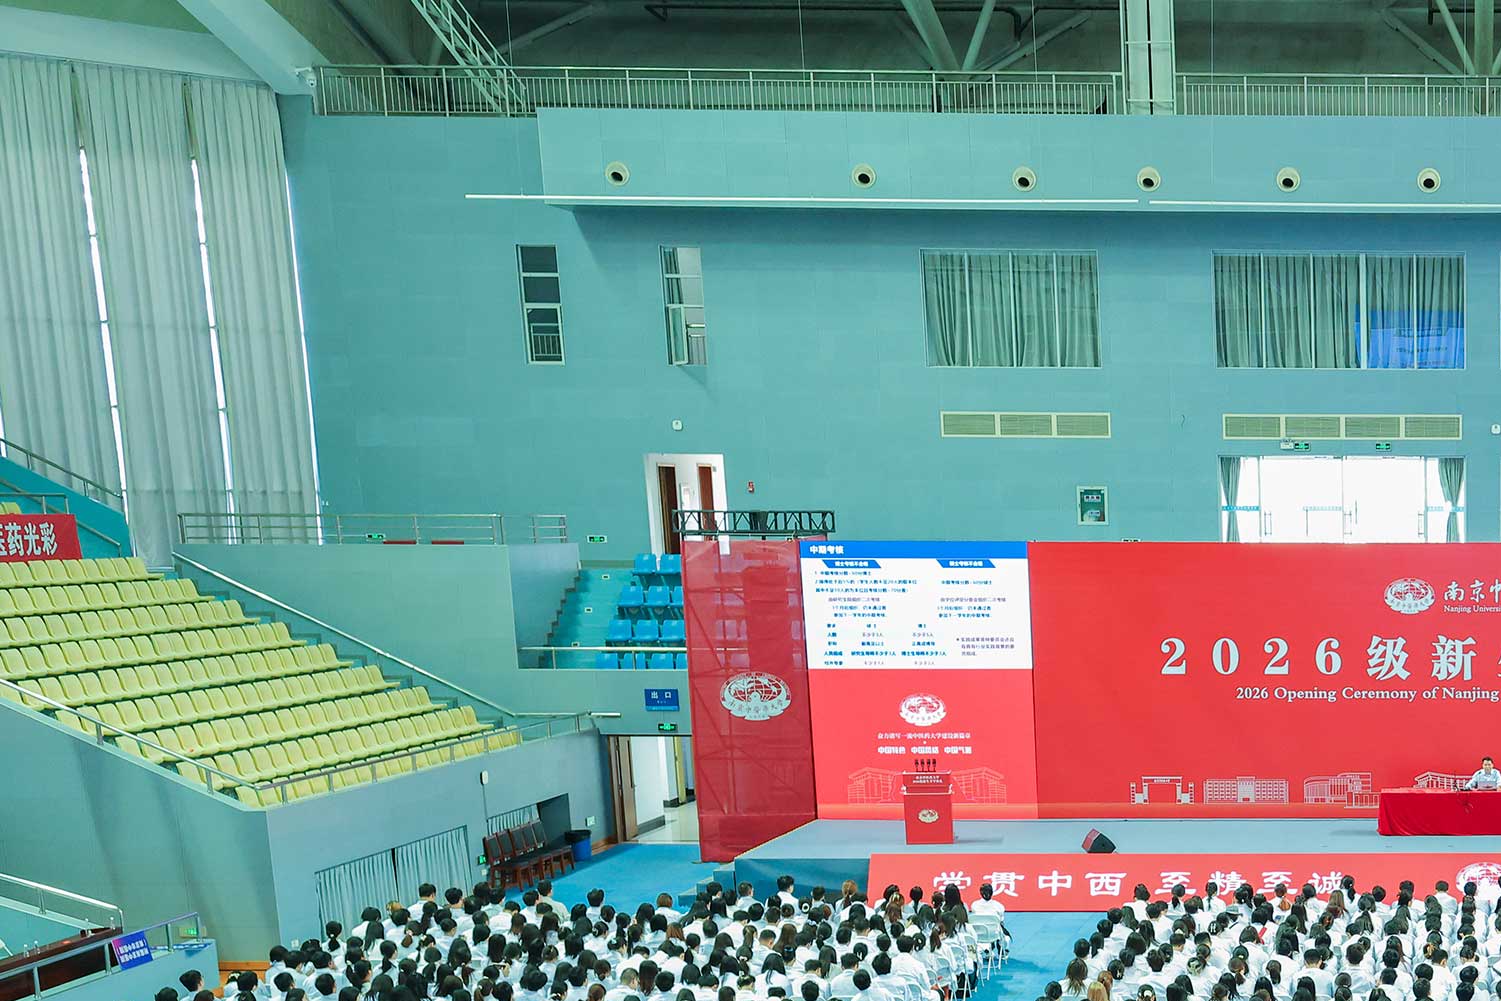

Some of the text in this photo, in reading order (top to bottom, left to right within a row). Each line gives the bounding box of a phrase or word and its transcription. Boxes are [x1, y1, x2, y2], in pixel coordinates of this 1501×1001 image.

[810, 545, 843, 554] 中期考核
[1237, 687, 1268, 698] 2026
[1275, 687, 1336, 702] Opening
[1342, 687, 1416, 702] Ceremony
[1423, 687, 1439, 698] of
[1442, 687, 1499, 702] Nanjing
